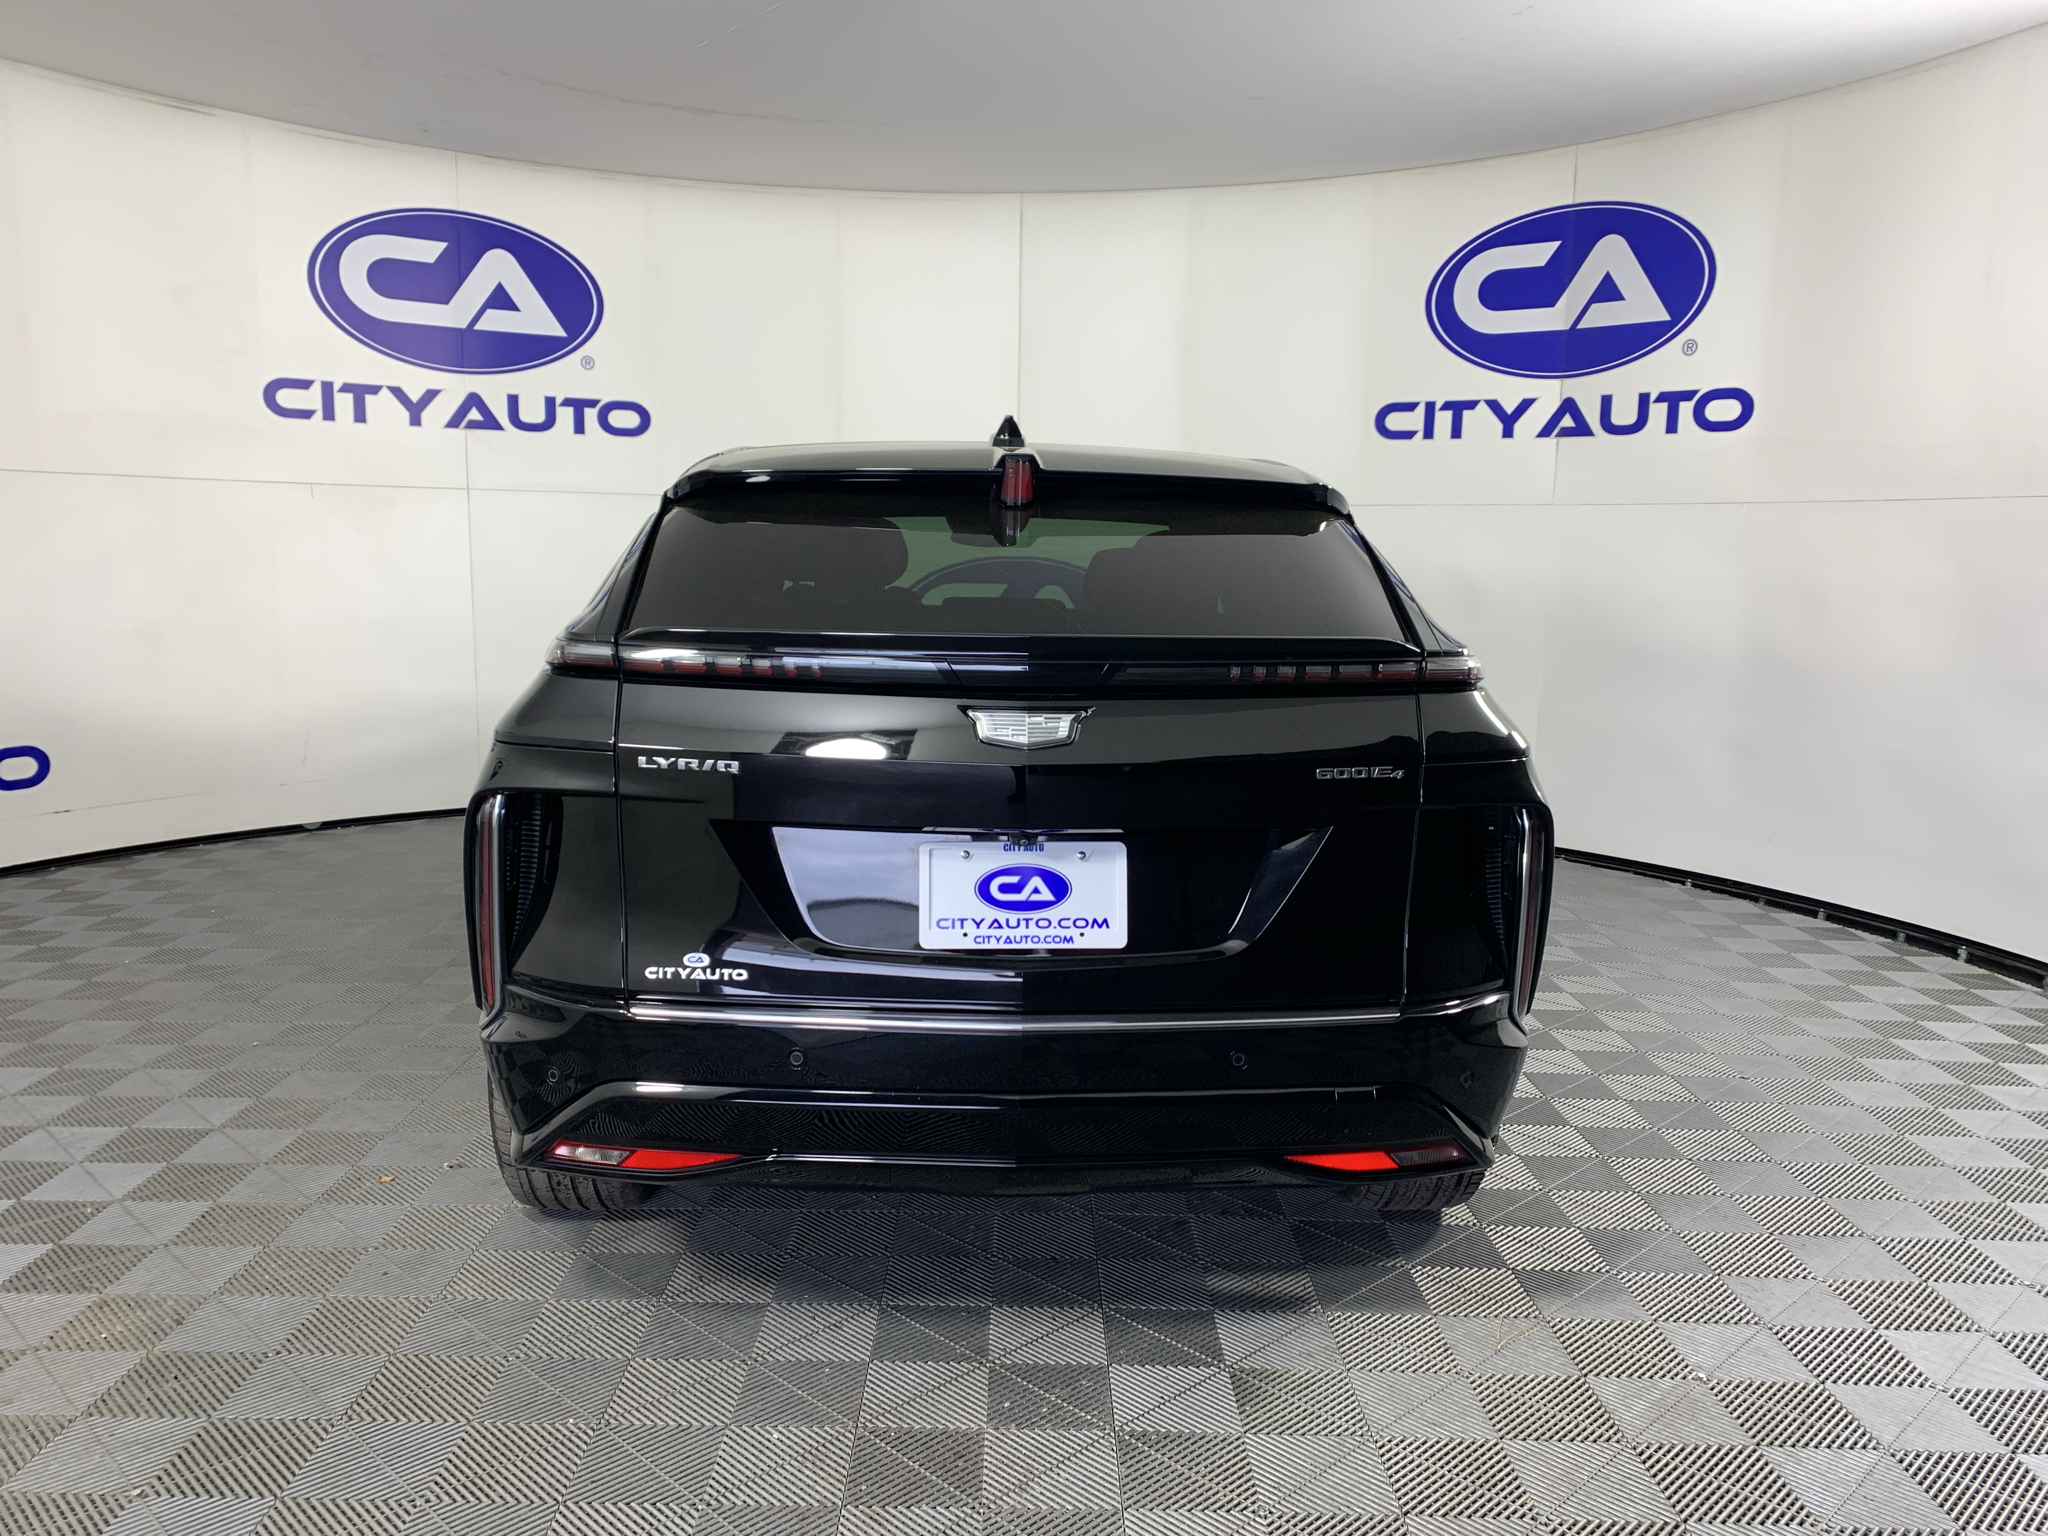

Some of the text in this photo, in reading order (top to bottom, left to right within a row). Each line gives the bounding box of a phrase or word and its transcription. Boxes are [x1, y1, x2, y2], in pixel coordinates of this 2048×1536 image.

[339, 233, 567, 336] CA
[1453, 233, 1672, 334] CA
[989, 875, 1057, 902] CA
[936, 917, 1110, 930] CITYAUTO.COM
[973, 935, 1075, 945] CITYAUTO.COM
